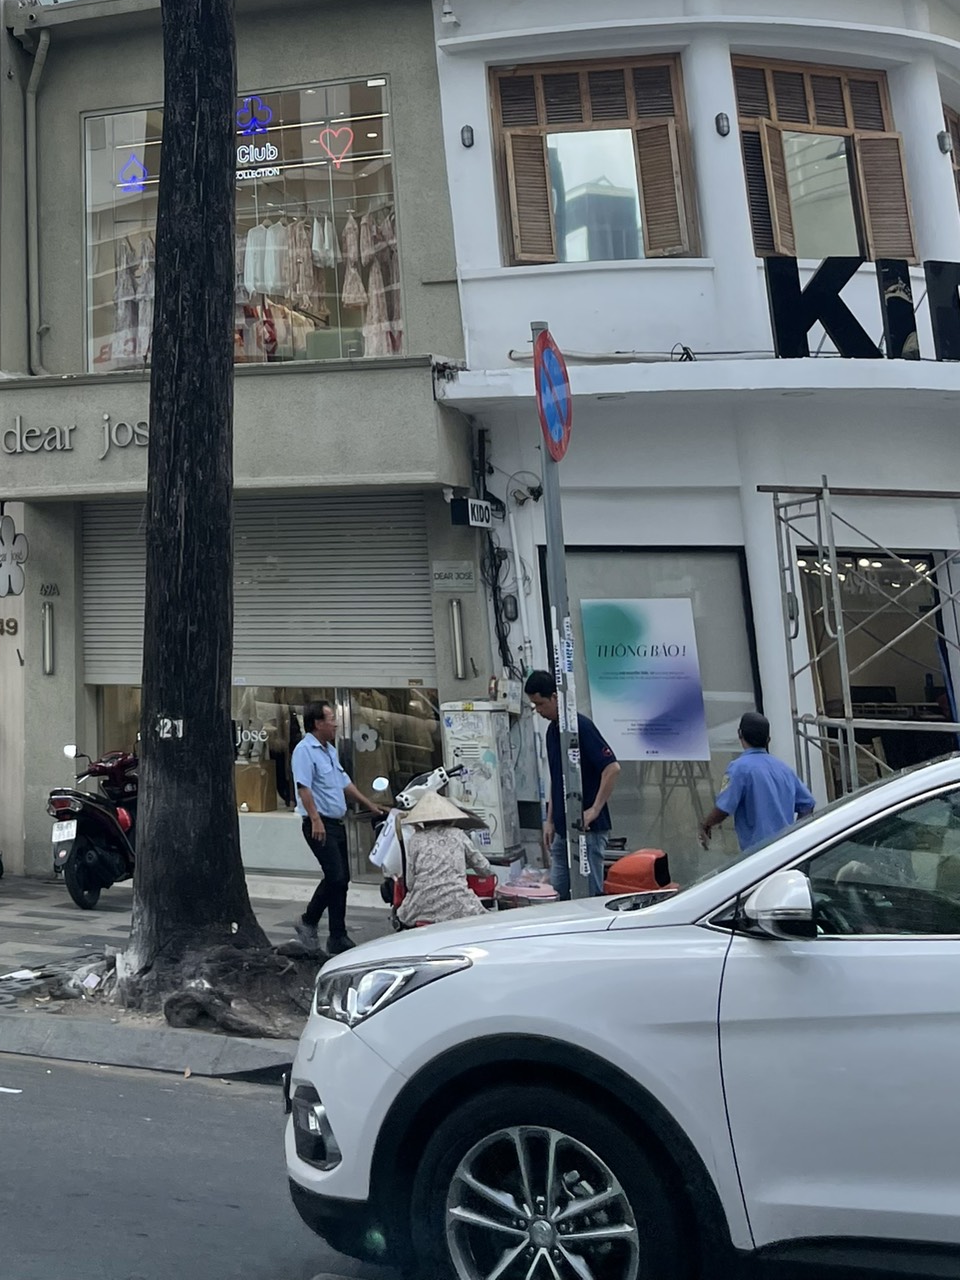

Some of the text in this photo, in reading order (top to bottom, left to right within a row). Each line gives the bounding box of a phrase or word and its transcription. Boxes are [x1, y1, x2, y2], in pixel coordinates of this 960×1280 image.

[2, 413, 150, 460] dear jos
[470, 503, 491, 524] KIDO
[433, 571, 454, 581] DEAR
[40, 583, 60, 597] 49A
[596, 642, 648, 658] THÔNG
[650, 640, 680, 658] BÁO
[235, 725, 270, 747] josé
